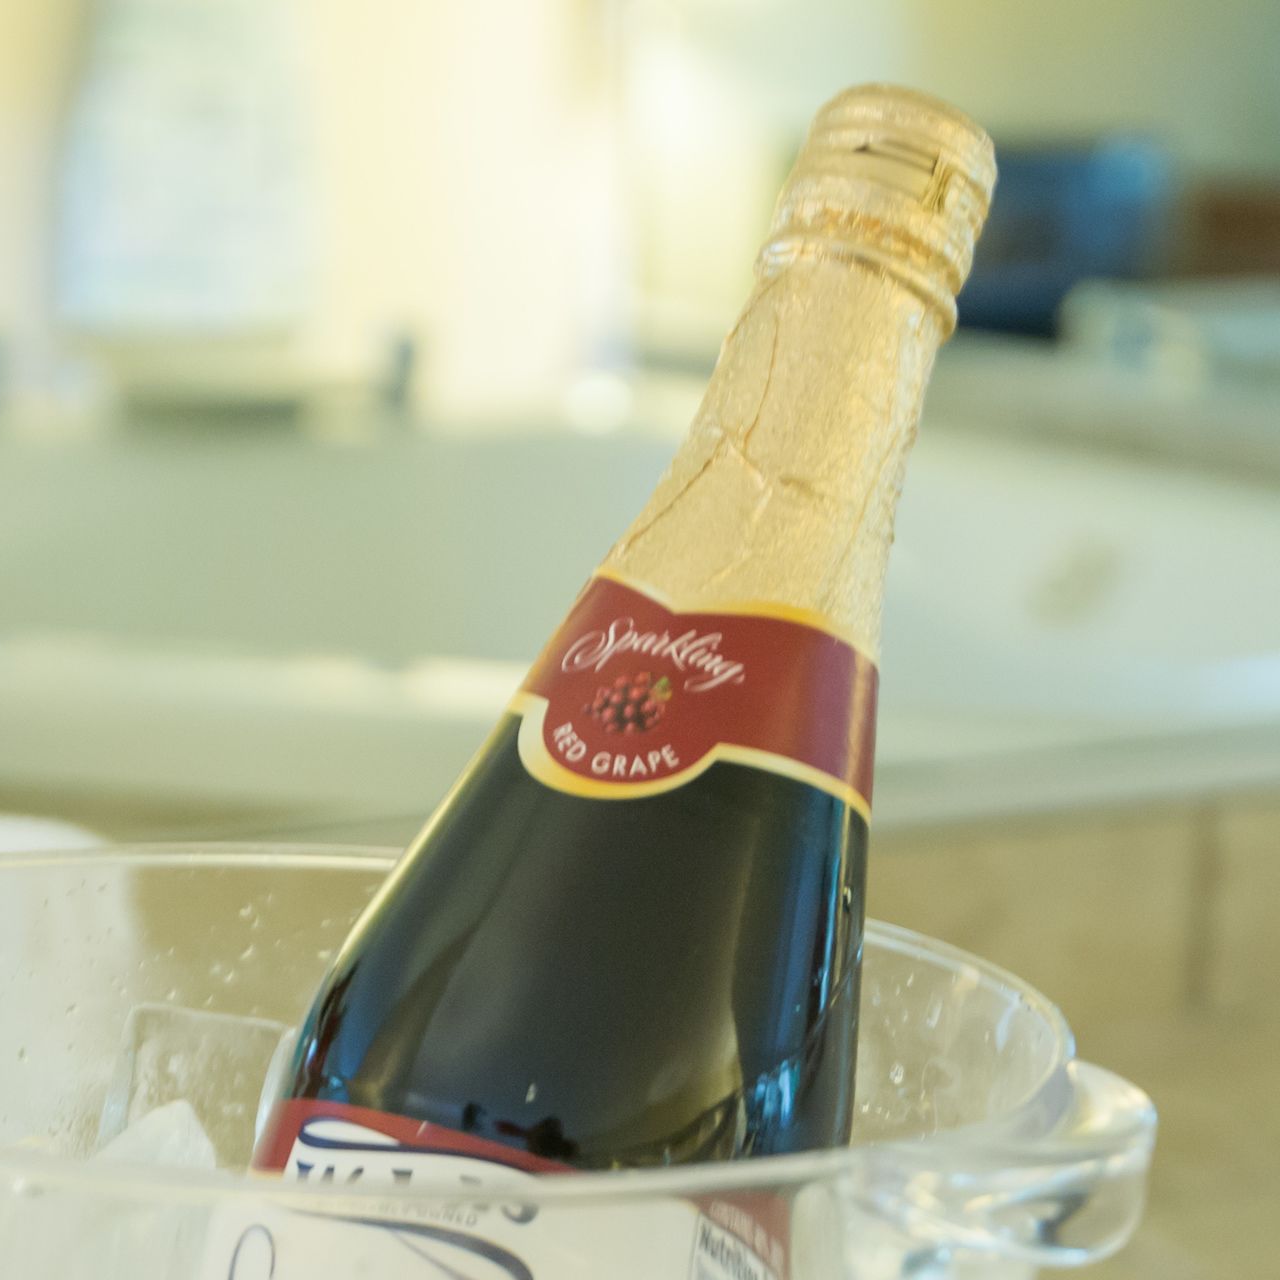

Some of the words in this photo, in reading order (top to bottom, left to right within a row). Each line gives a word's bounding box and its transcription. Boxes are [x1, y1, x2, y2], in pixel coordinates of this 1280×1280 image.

[561, 618, 745, 692] Sparkling
[552, 723, 587, 762] RED
[591, 745, 680, 777] GRAPE
